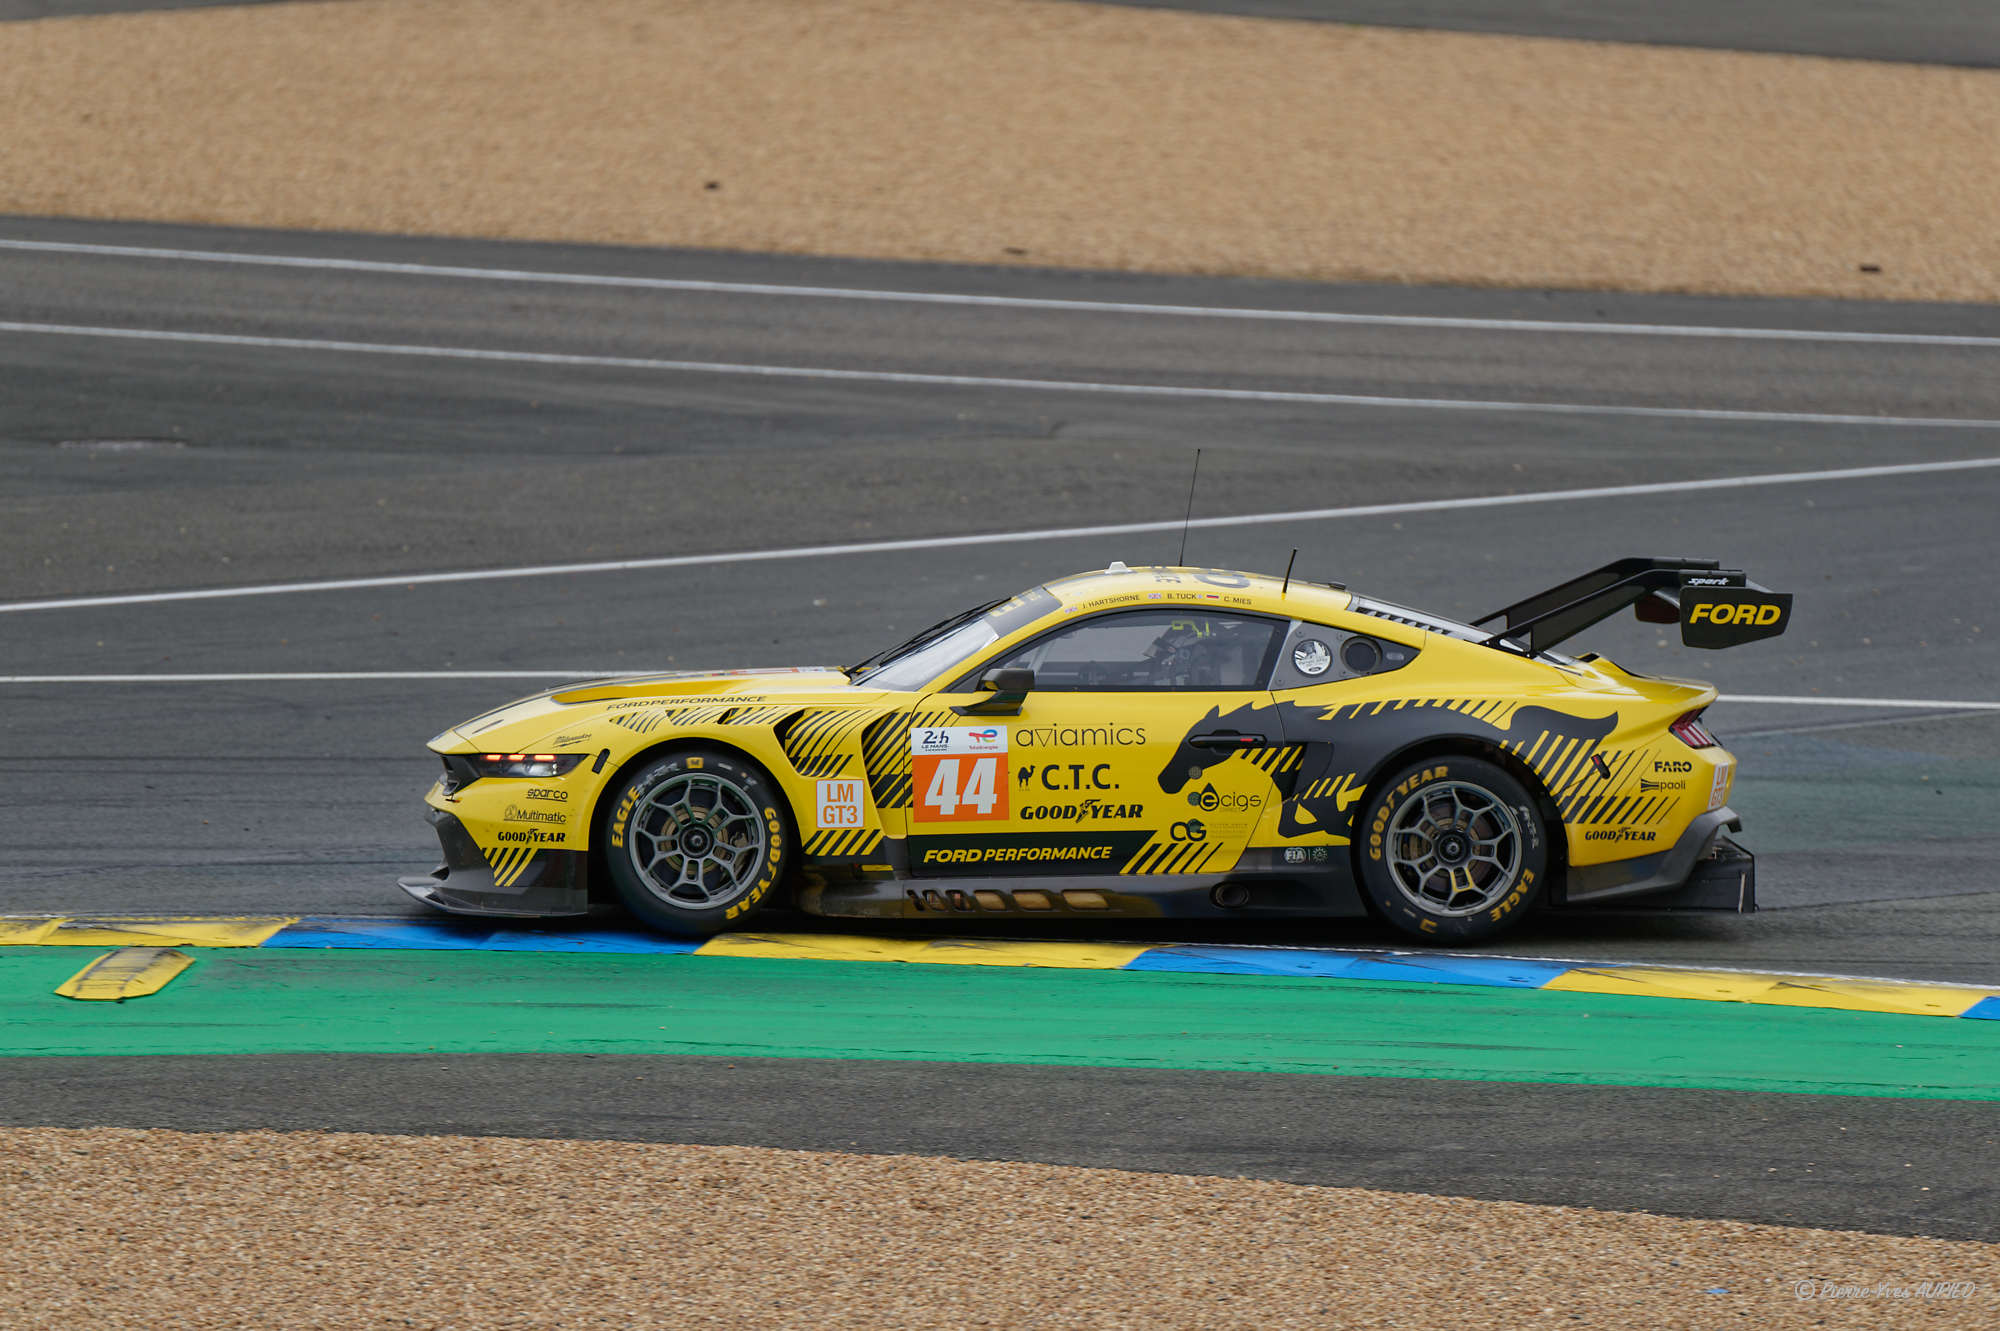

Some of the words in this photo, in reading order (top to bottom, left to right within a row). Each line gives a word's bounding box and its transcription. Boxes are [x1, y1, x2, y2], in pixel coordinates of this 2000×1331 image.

[1688, 577, 1728, 586] spark
[1088, 594, 1140, 608] HARTSHORNE
[1232, 596, 1253, 605] MIES
[1689, 603, 1781, 626] FORD
[1016, 722, 1146, 747] aviamics
[1655, 761, 1692, 773] FARO
[1041, 763, 1120, 790] C.T.C.
[527, 787, 568, 800] sparco
[826, 783, 854, 803] LM
[924, 758, 998, 815] 44
[1660, 780, 1686, 792] paoli
[517, 809, 567, 823] Multimatic
[612, 785, 640, 848] EAGLE
[823, 805, 858, 824] GT3
[923, 849, 982, 863] FORD
[983, 846, 1112, 861] PERFORMANCE
[1287, 850, 1305, 860] FIA
[1490, 868, 1535, 922] EAGLE
